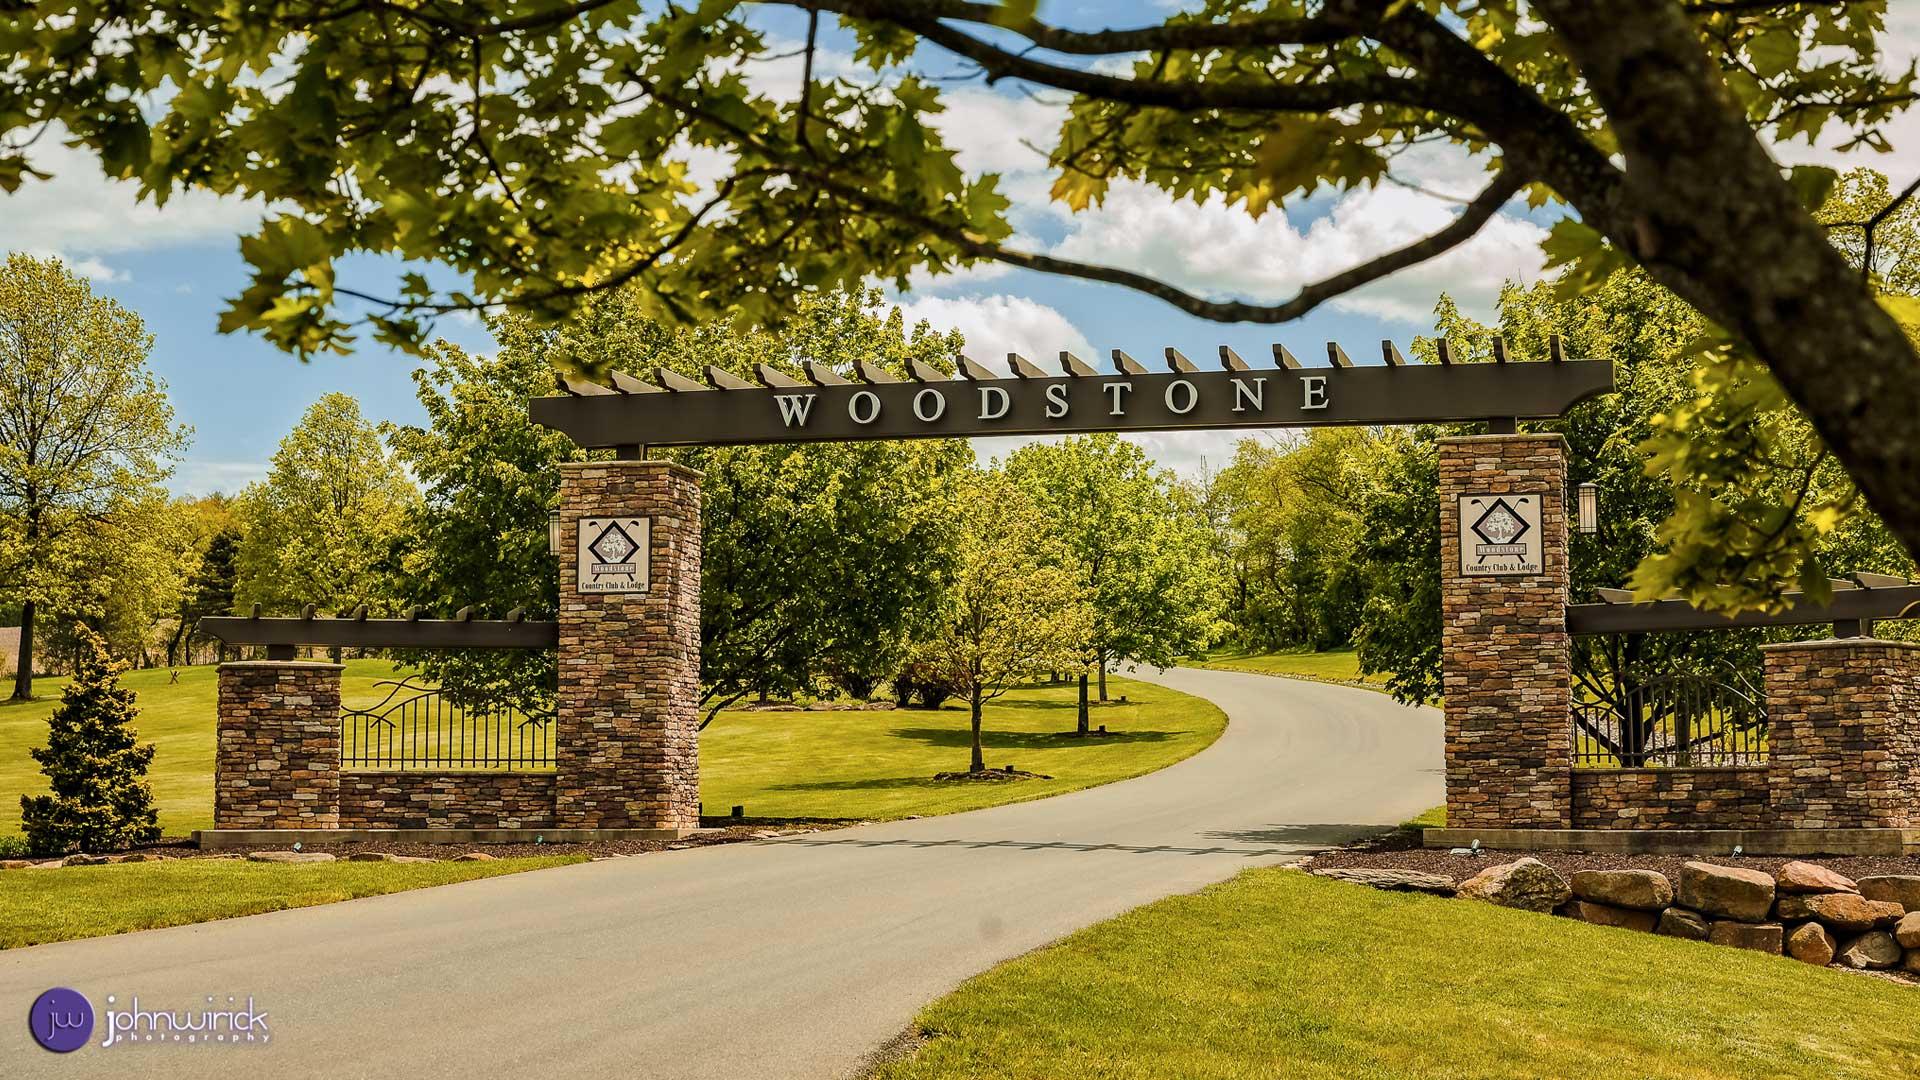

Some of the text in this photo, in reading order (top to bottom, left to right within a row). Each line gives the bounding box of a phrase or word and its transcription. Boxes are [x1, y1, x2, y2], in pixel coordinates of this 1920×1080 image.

[773, 376, 1329, 427] WOODSTONE
[1465, 562, 1538, 573] Country Club & Lodge
[581, 580, 645, 590] Country Club & Lodge
